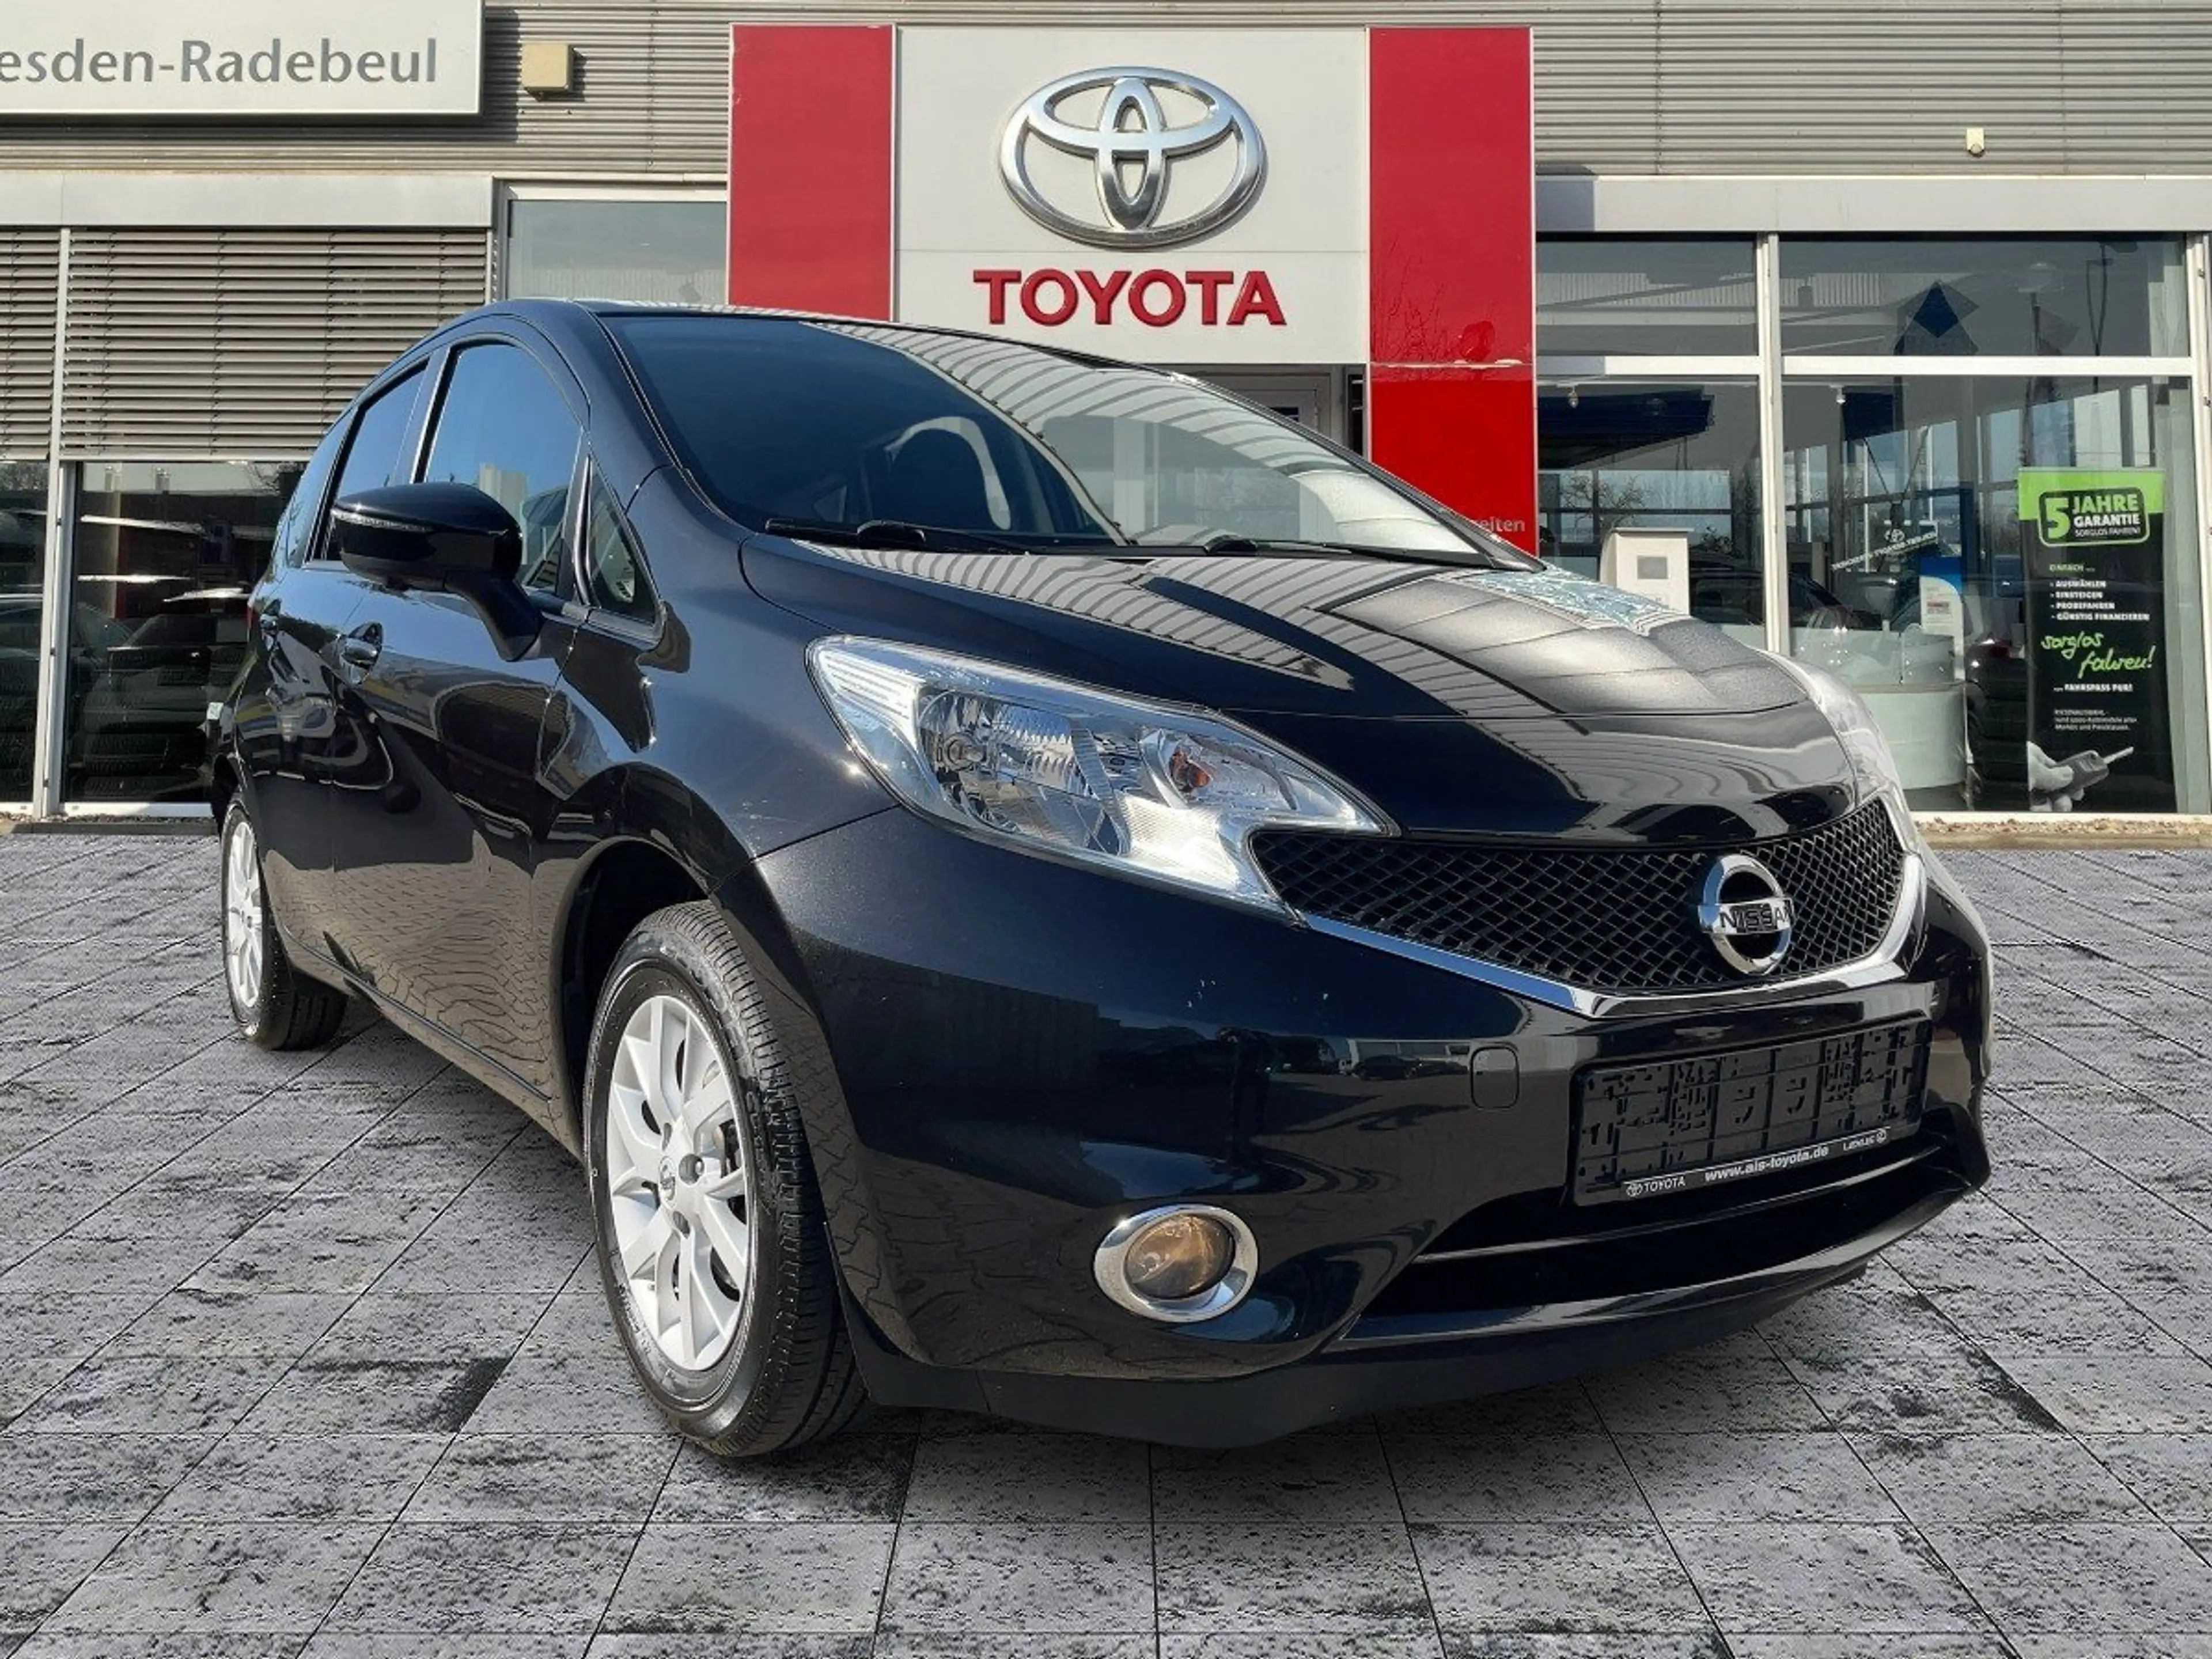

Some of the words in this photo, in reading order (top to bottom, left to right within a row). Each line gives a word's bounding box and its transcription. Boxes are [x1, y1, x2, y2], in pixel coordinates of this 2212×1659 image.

[973, 268, 1287, 327] TOYOTA
[2073, 494, 2139, 514] JAHRE
[1475, 516, 1526, 532] eiten
[2046, 497, 2070, 539] 5
[2074, 514, 2141, 527] GARANTIE
[2056, 612, 2093, 620] GÜNSTIG
[2094, 612, 2150, 620] FINANZIEREN
[2041, 630, 2104, 660] sorglos
[1719, 899, 1794, 930] NISSAN
[1645, 1176, 1685, 1192] TOYOTA
